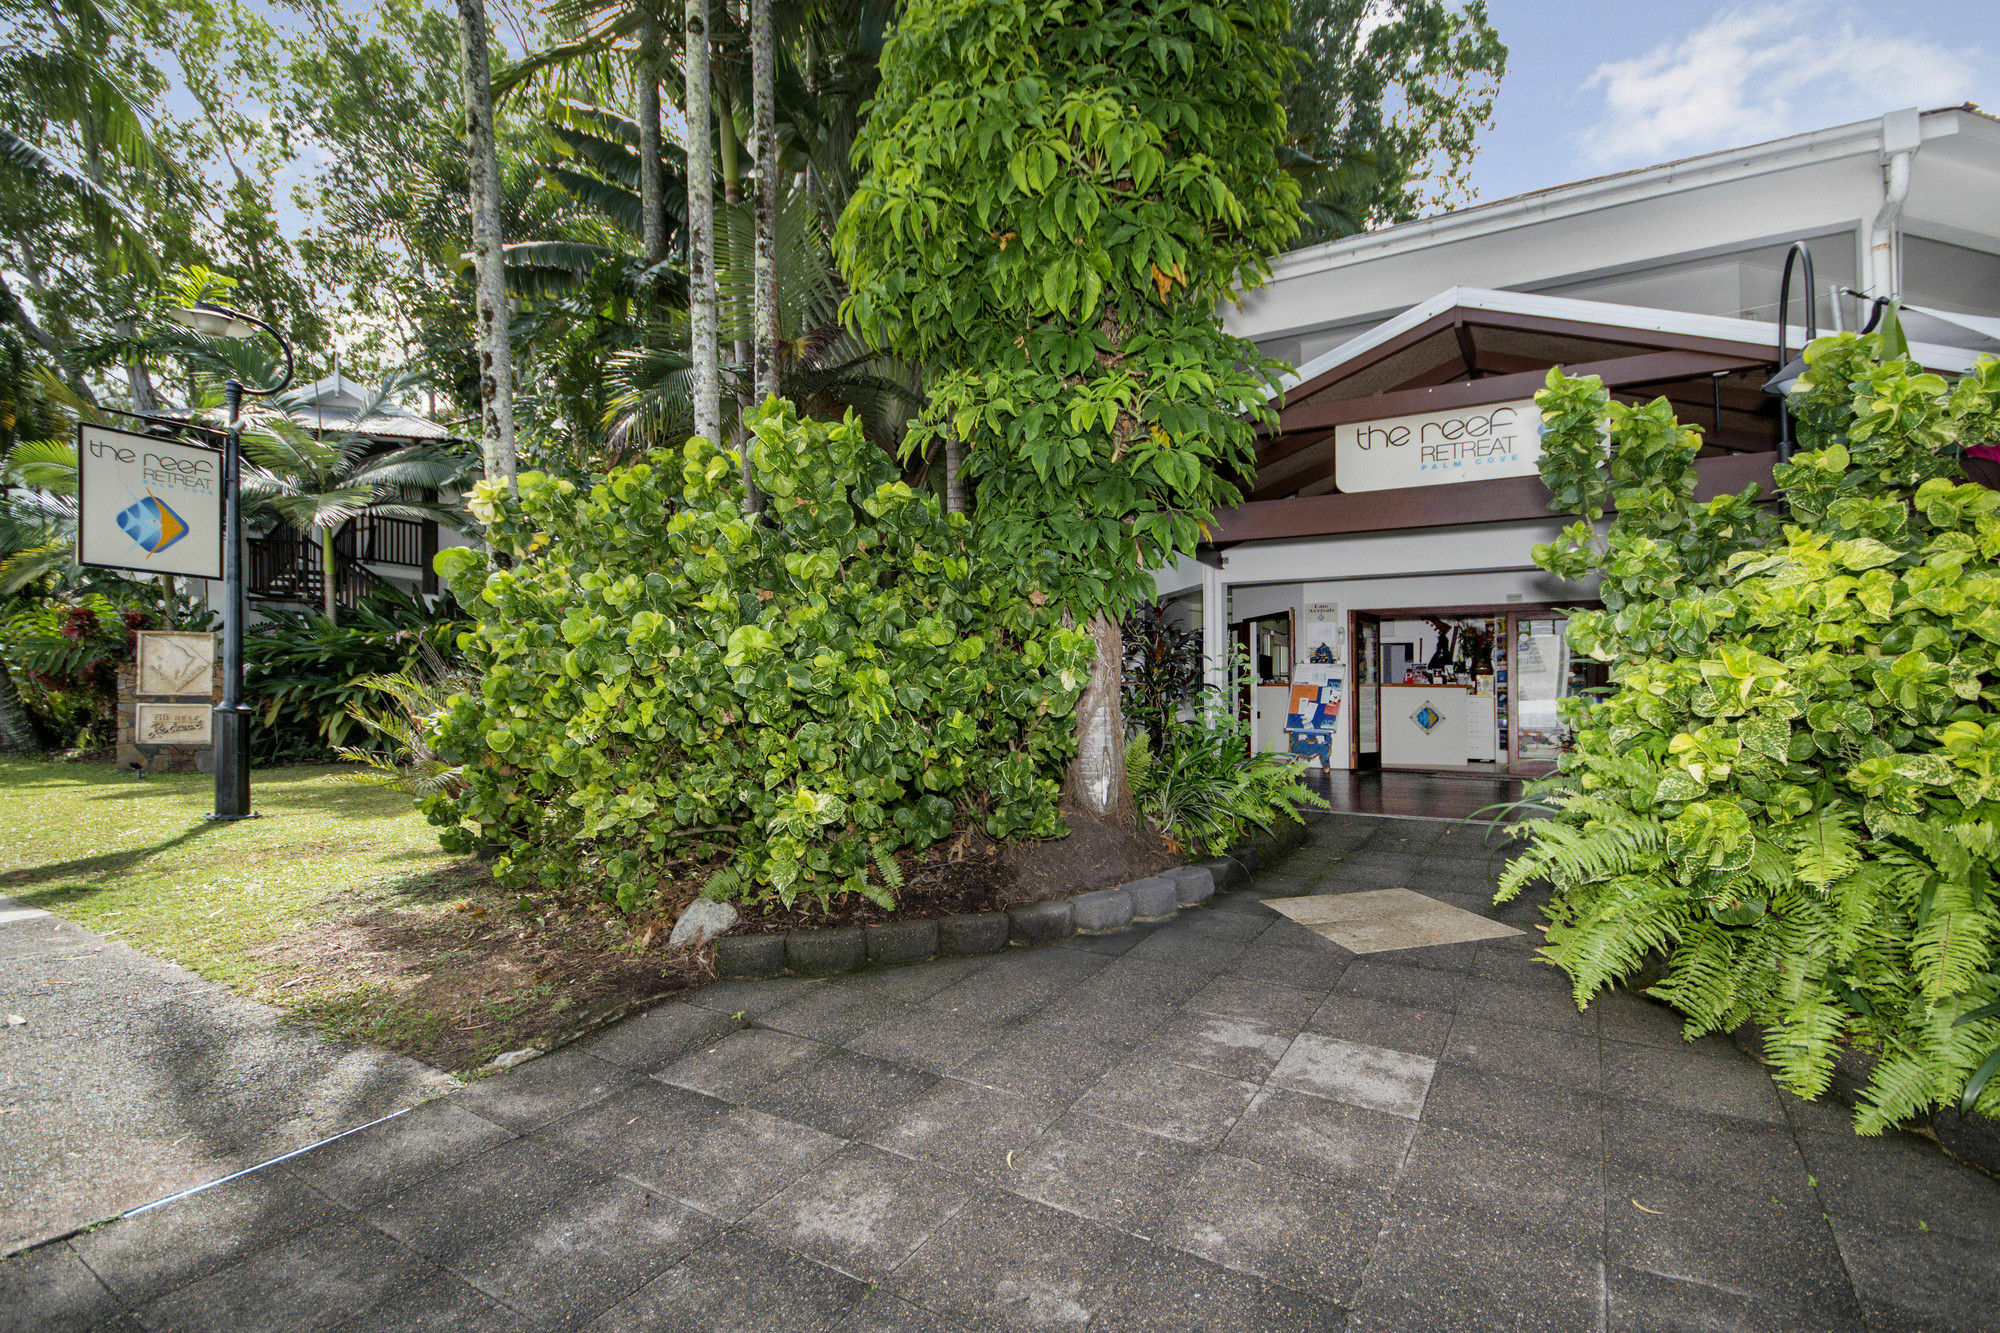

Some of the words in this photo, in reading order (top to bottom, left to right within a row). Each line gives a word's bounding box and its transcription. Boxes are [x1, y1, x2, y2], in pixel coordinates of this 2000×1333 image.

[1356, 420, 1411, 451] the
[1421, 406, 1518, 445] reef
[89, 439, 136, 464] the
[143, 453, 214, 476] reef
[1421, 435, 1518, 464] RETREAT
[1421, 459, 1462, 471] PALM
[1475, 453, 1518, 466] COVE
[143, 467, 214, 490] RETREAT
